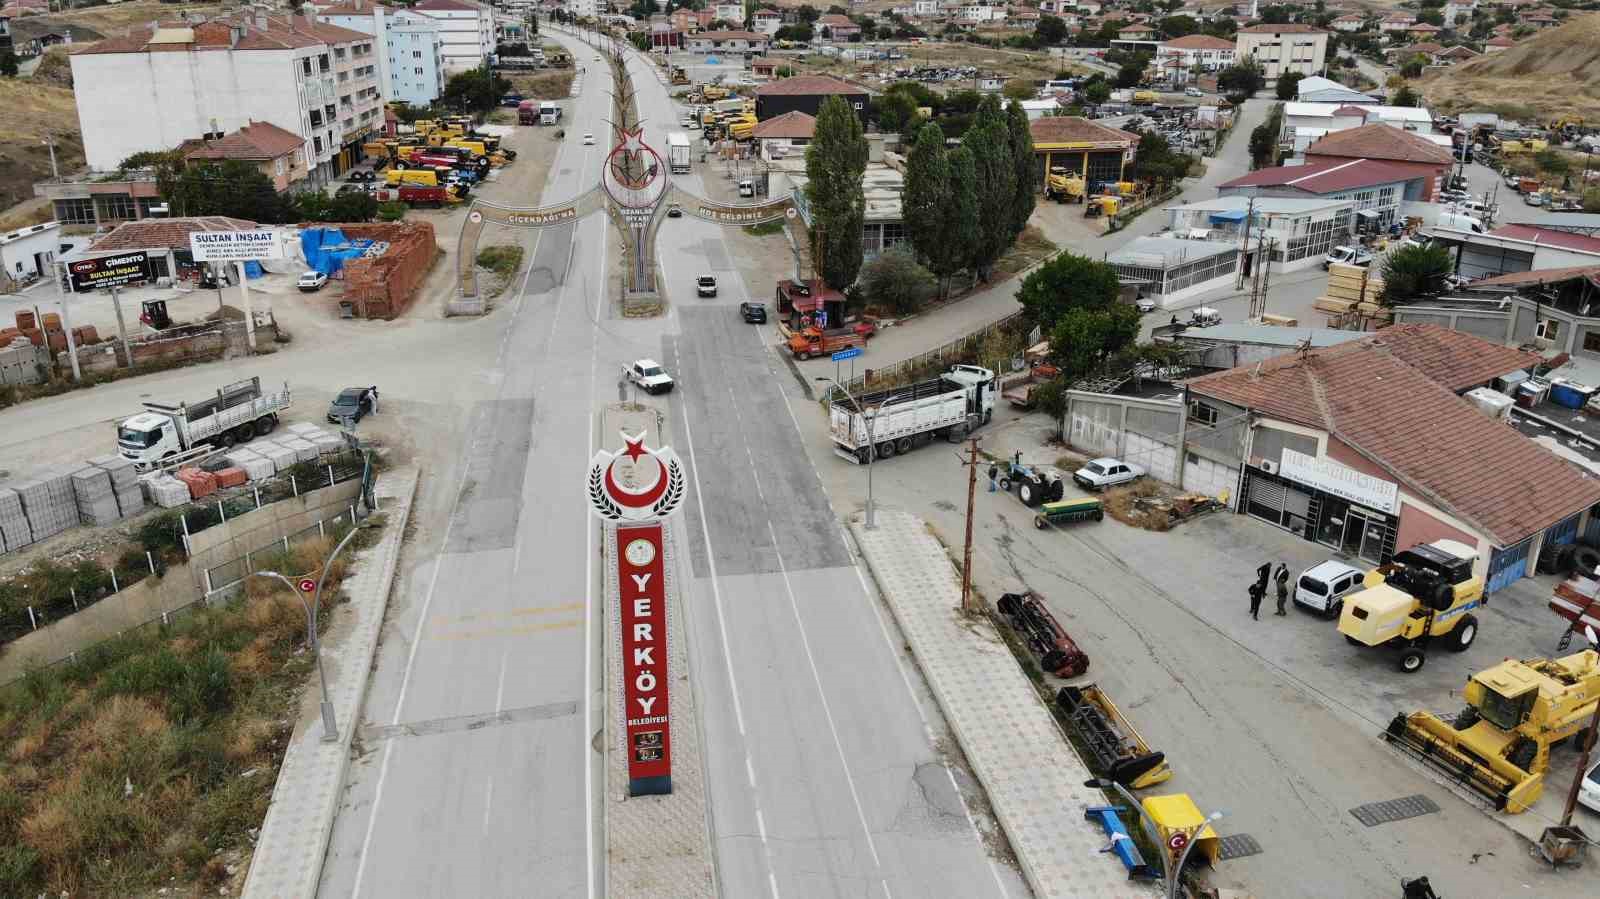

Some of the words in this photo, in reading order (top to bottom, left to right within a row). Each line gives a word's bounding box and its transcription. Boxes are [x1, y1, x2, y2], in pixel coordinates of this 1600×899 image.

[195, 234, 232, 243] SULTAN
[631, 573, 658, 715] YERKÖY
[628, 715, 668, 726] BELEDİYESİ
